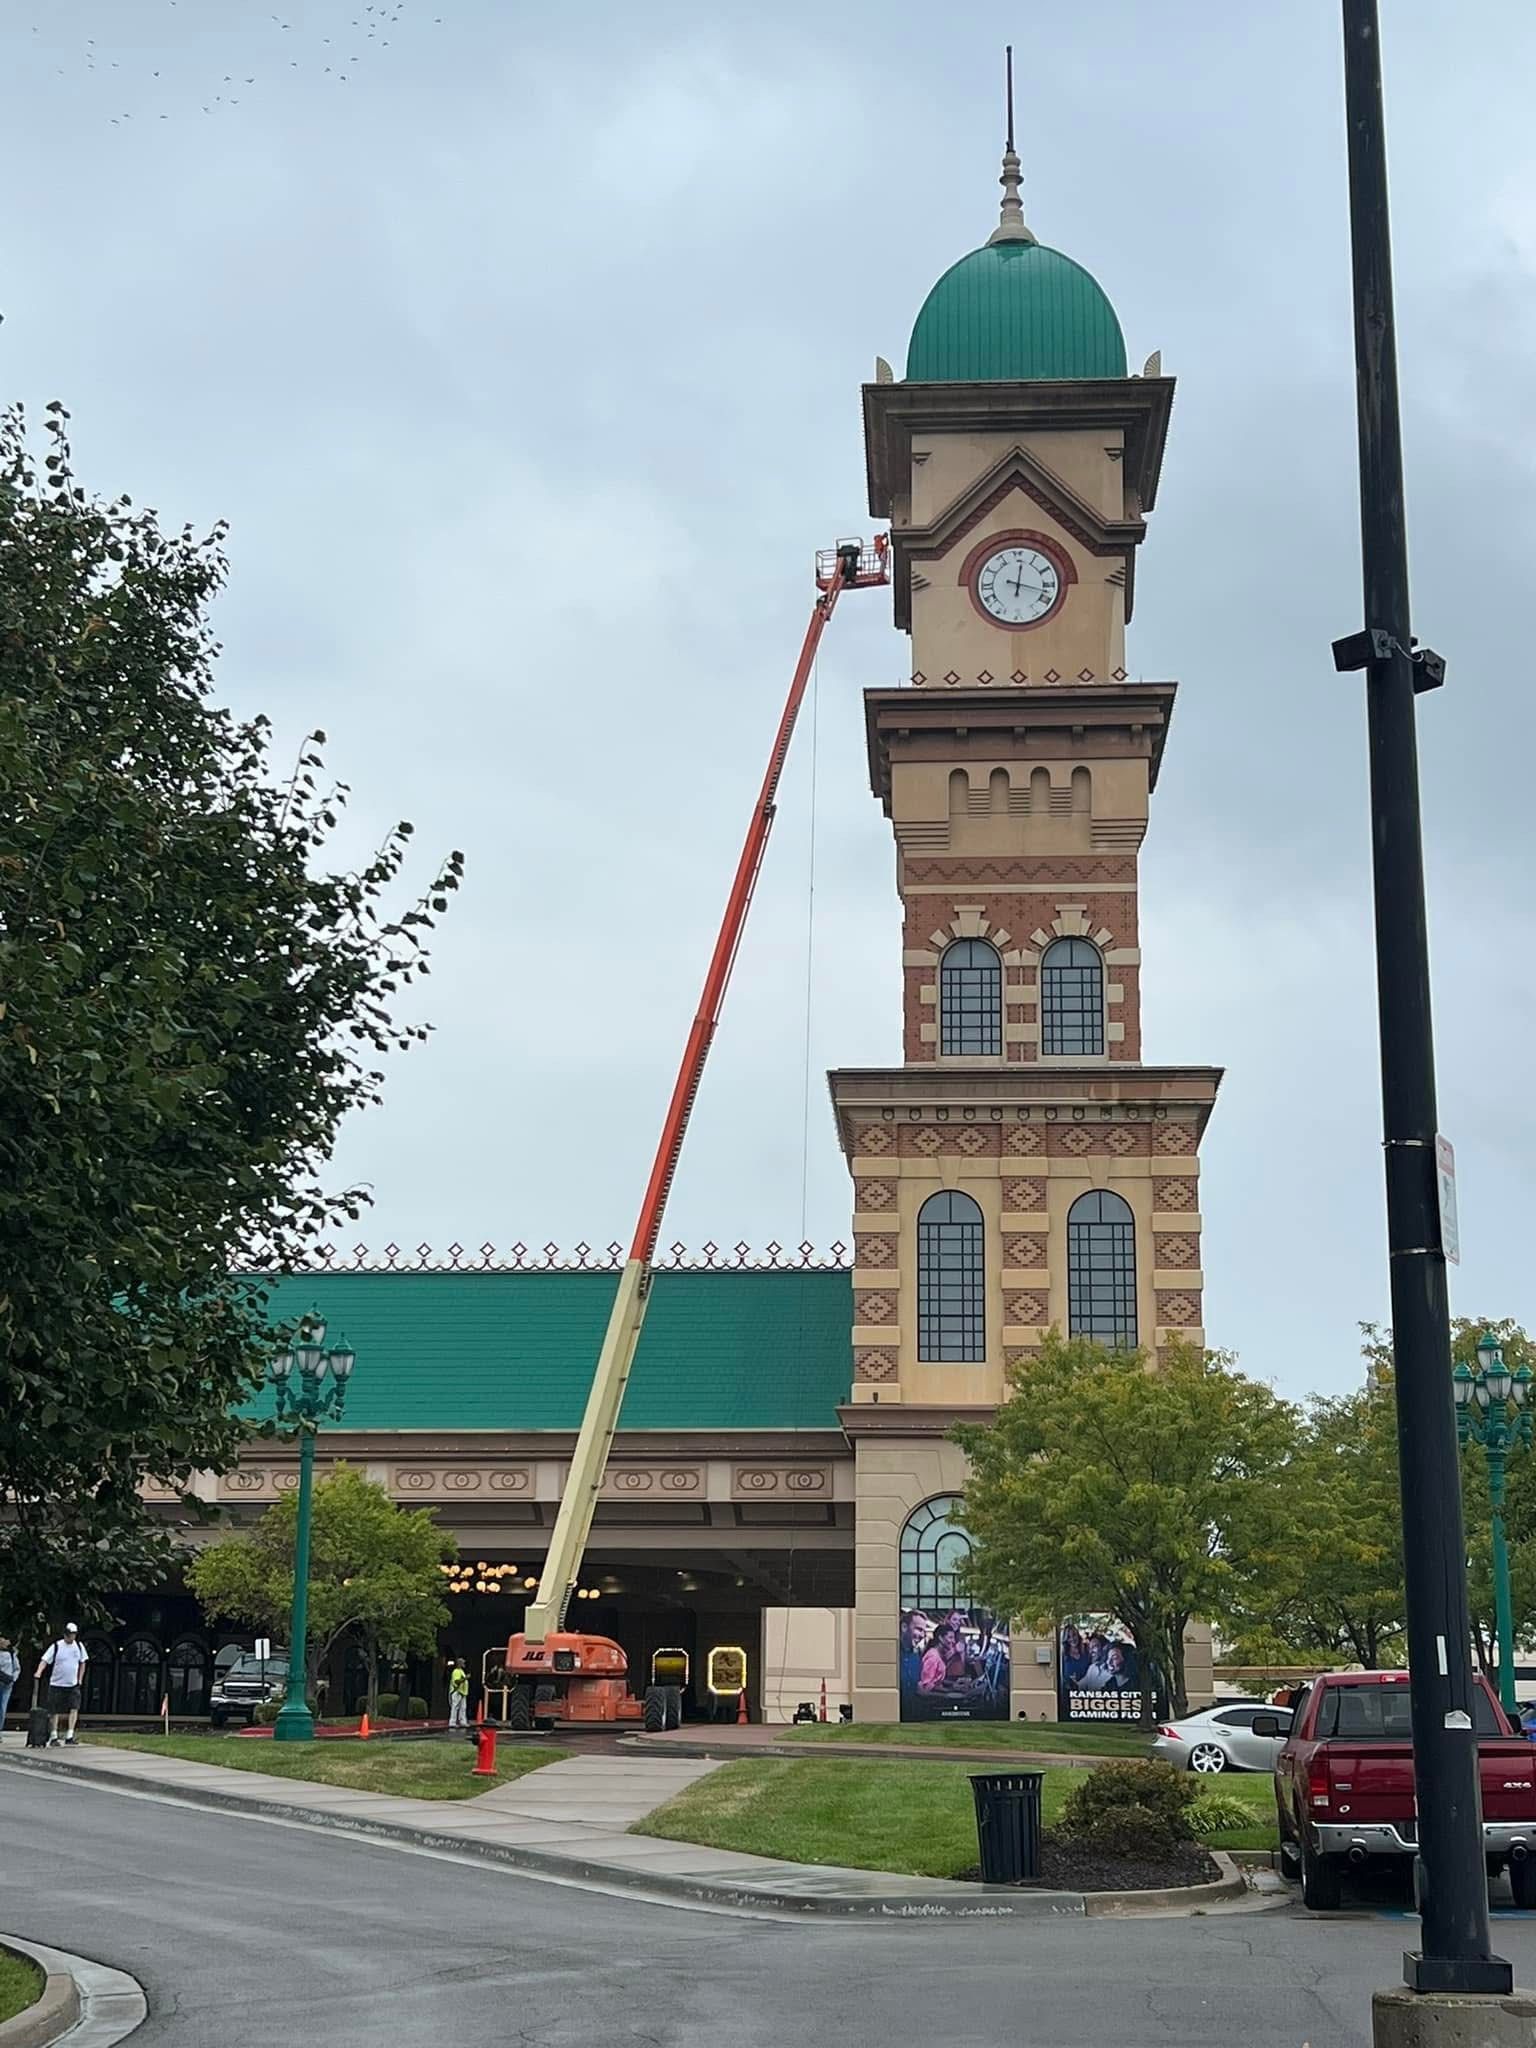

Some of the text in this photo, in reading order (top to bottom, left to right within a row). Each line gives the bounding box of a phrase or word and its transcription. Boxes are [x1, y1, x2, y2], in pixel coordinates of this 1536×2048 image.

[521, 1651, 546, 1661] JLG
[1069, 1690, 1118, 1699] KANSAS
[1070, 1699, 1157, 1711] BIGGES
[1069, 1711, 1118, 1719] GAMING
